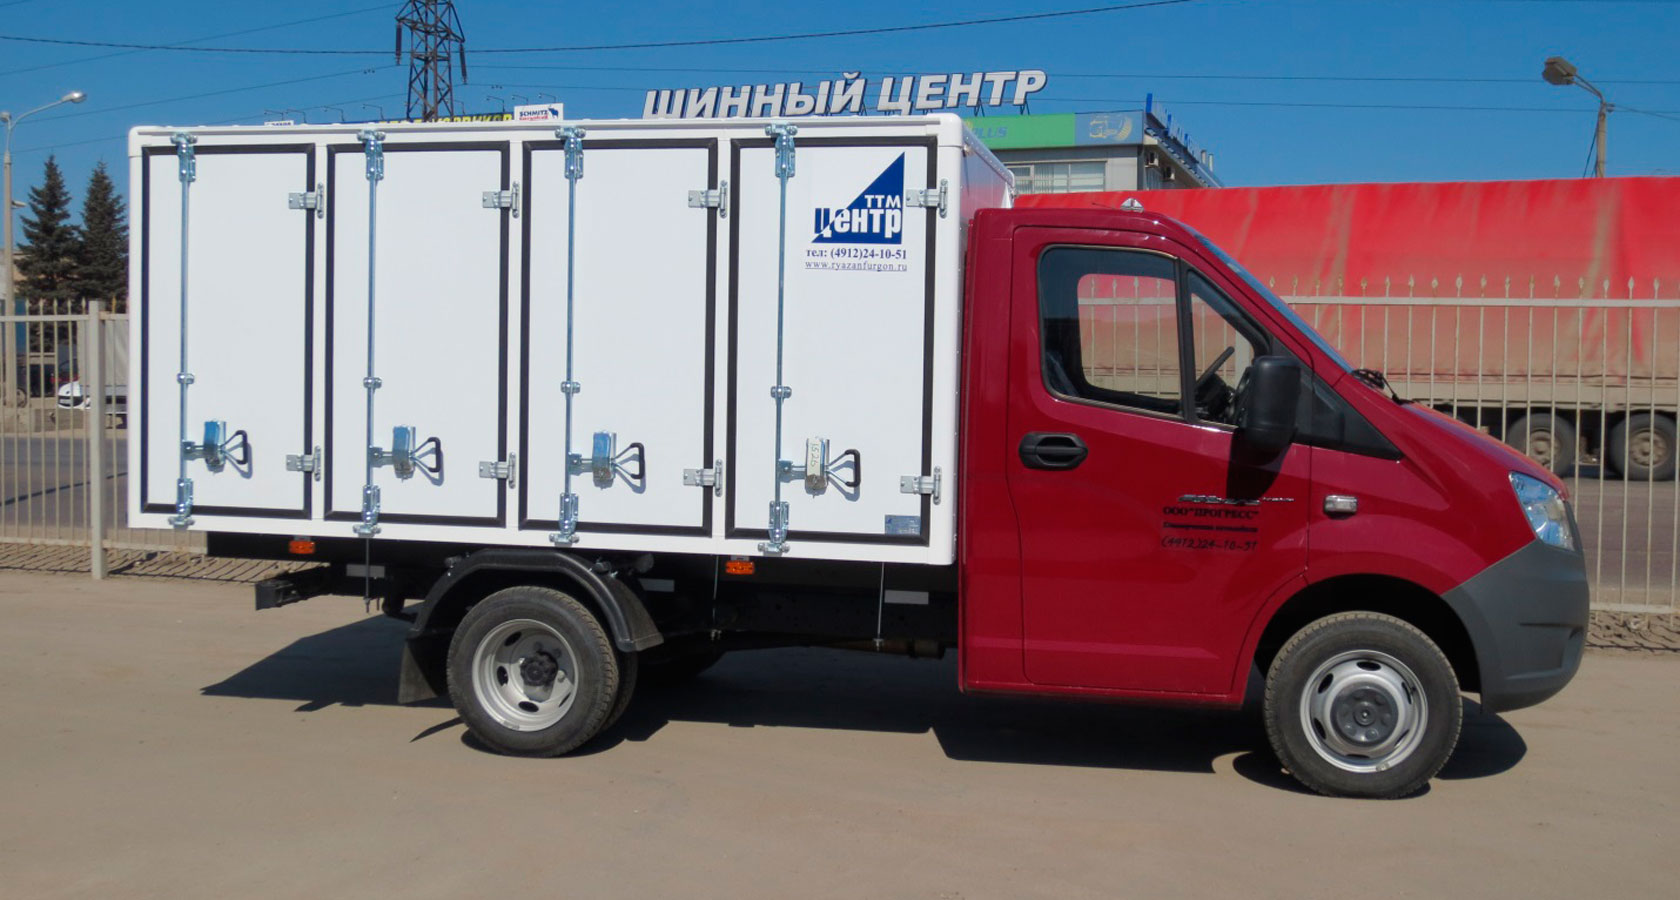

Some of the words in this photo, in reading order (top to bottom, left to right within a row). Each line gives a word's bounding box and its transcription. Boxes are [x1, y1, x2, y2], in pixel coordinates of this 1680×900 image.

[642, 71, 867, 118] ШИННЫЙ
[877, 70, 1047, 116] ЦЕНТР
[864, 194, 901, 208] ТТМ
[806, 248, 828, 257] тел:
[830, 247, 907, 260] (4912)24-10-51
[805, 260, 908, 272] www.ryazanfurgon.ru
